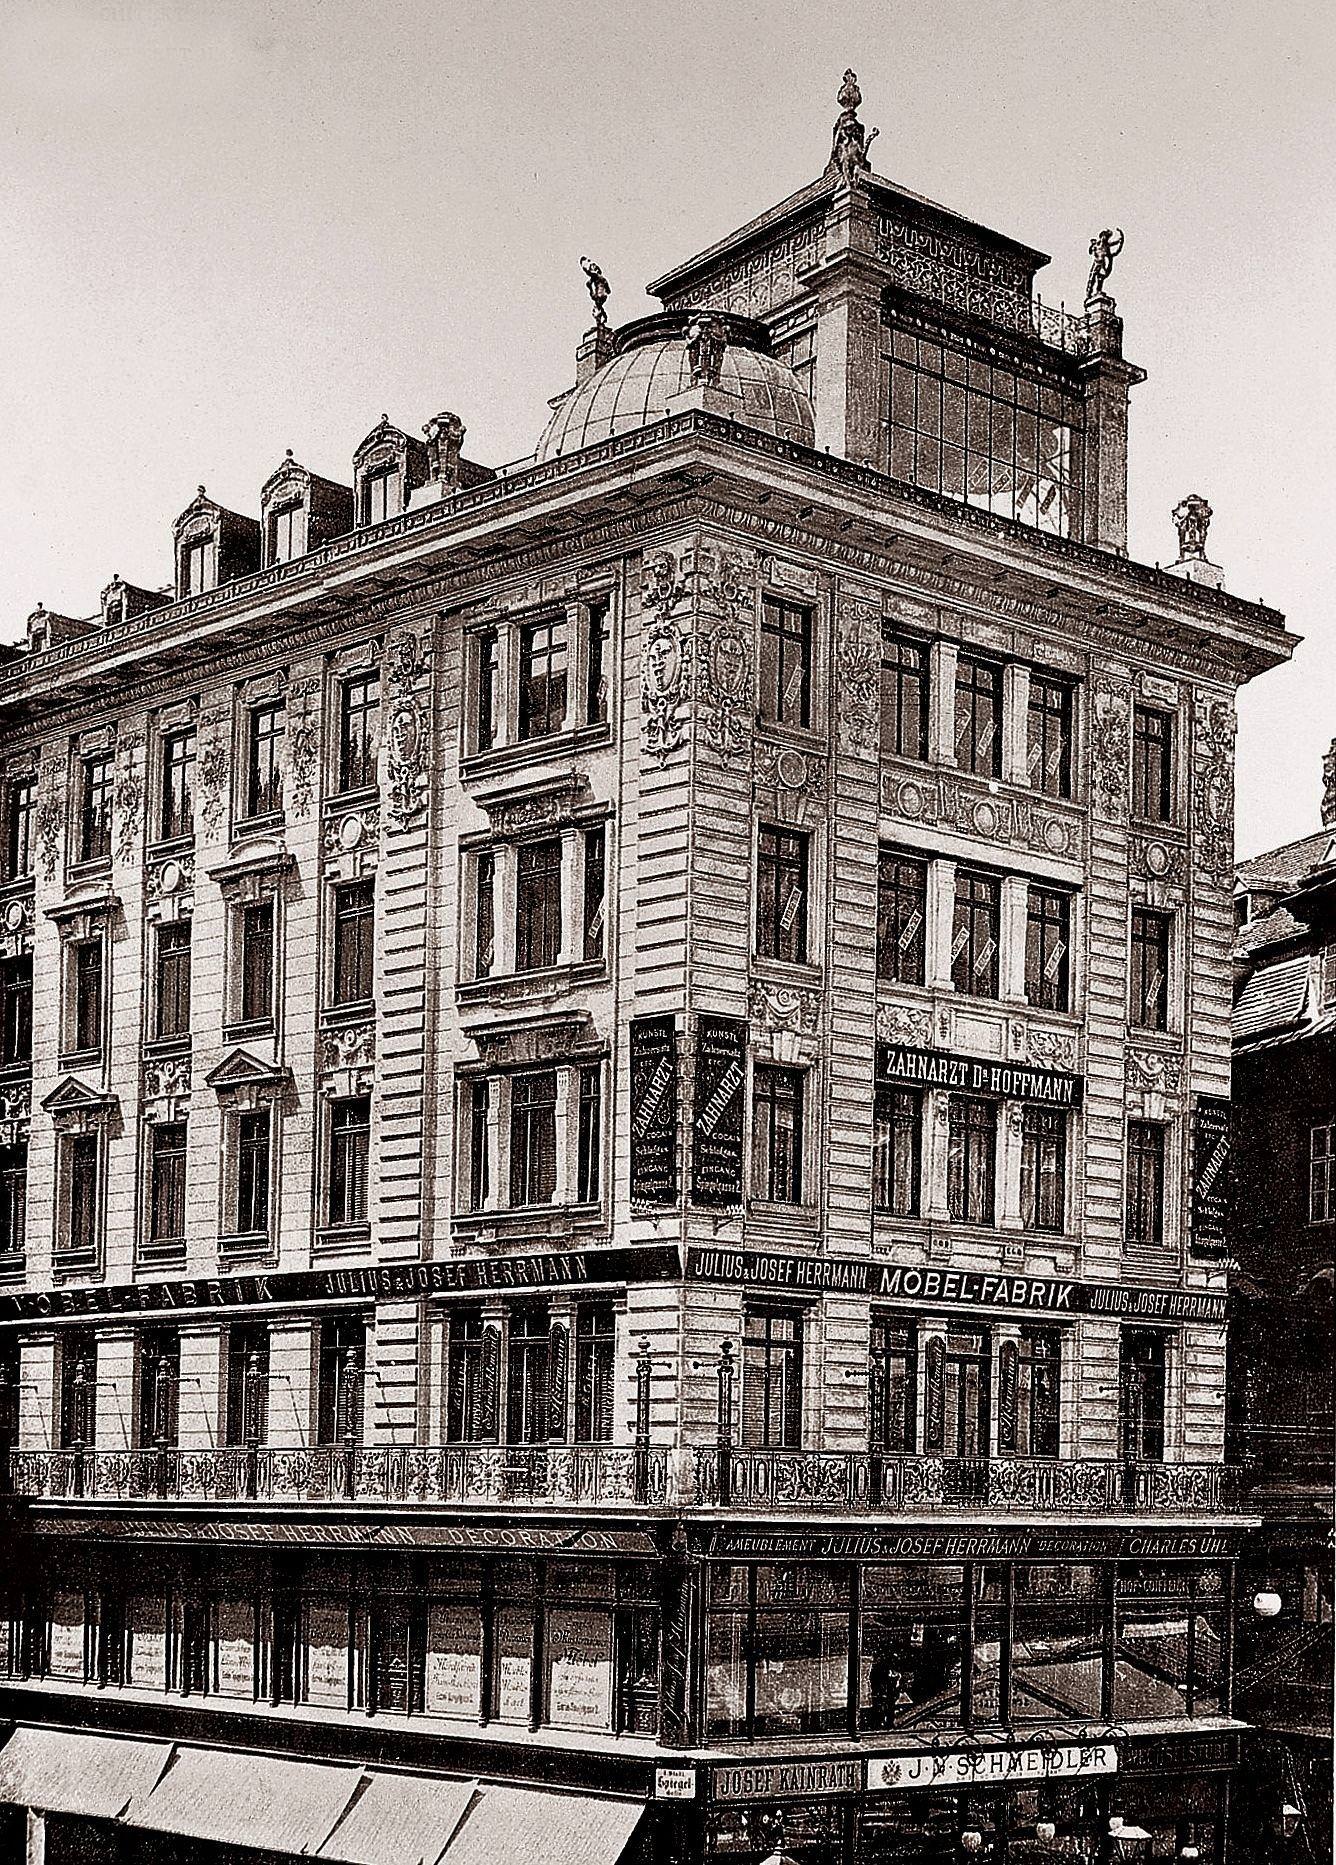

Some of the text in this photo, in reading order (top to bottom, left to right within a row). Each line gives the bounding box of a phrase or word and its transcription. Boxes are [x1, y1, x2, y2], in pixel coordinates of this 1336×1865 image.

[886, 1050, 969, 1086] ZAHNARZT
[990, 1067, 1074, 1103] HOFFMANN
[632, 1056, 674, 1138] ZAHNARZT
[695, 1060, 745, 1137] ZAHNARZT
[1195, 1134, 1231, 1200] ZAHNARZT
[326, 1269, 391, 1294] JULIUS
[405, 1263, 466, 1289] JOSEF
[475, 1255, 588, 1286] HERRMANN
[695, 1252, 744, 1279] JULIUS
[751, 1256, 794, 1283] JOSEF
[796, 1260, 868, 1290] HERRMANN
[879, 1267, 1075, 1309] MÖBEL-FABRIK
[1090, 1288, 1129, 1312] JULIUS
[1133, 1291, 1169, 1315] JOSEF
[1168, 1294, 1227, 1319] HERRMANN
[284, 1523, 416, 1546] HERRMANN
[448, 1528, 619, 1550] DECORATION
[726, 1537, 817, 1551] AMEUBLEMENT
[821, 1536, 882, 1555] JULIUS
[888, 1536, 945, 1555] JOSEF
[944, 1536, 1032, 1556] HERRMANN
[1129, 1537, 1229, 1554] CHARLES UHL
[956, 1745, 1108, 1777] SCHMEIDLER
[720, 1763, 856, 1796] JOSEF KAINRATH
